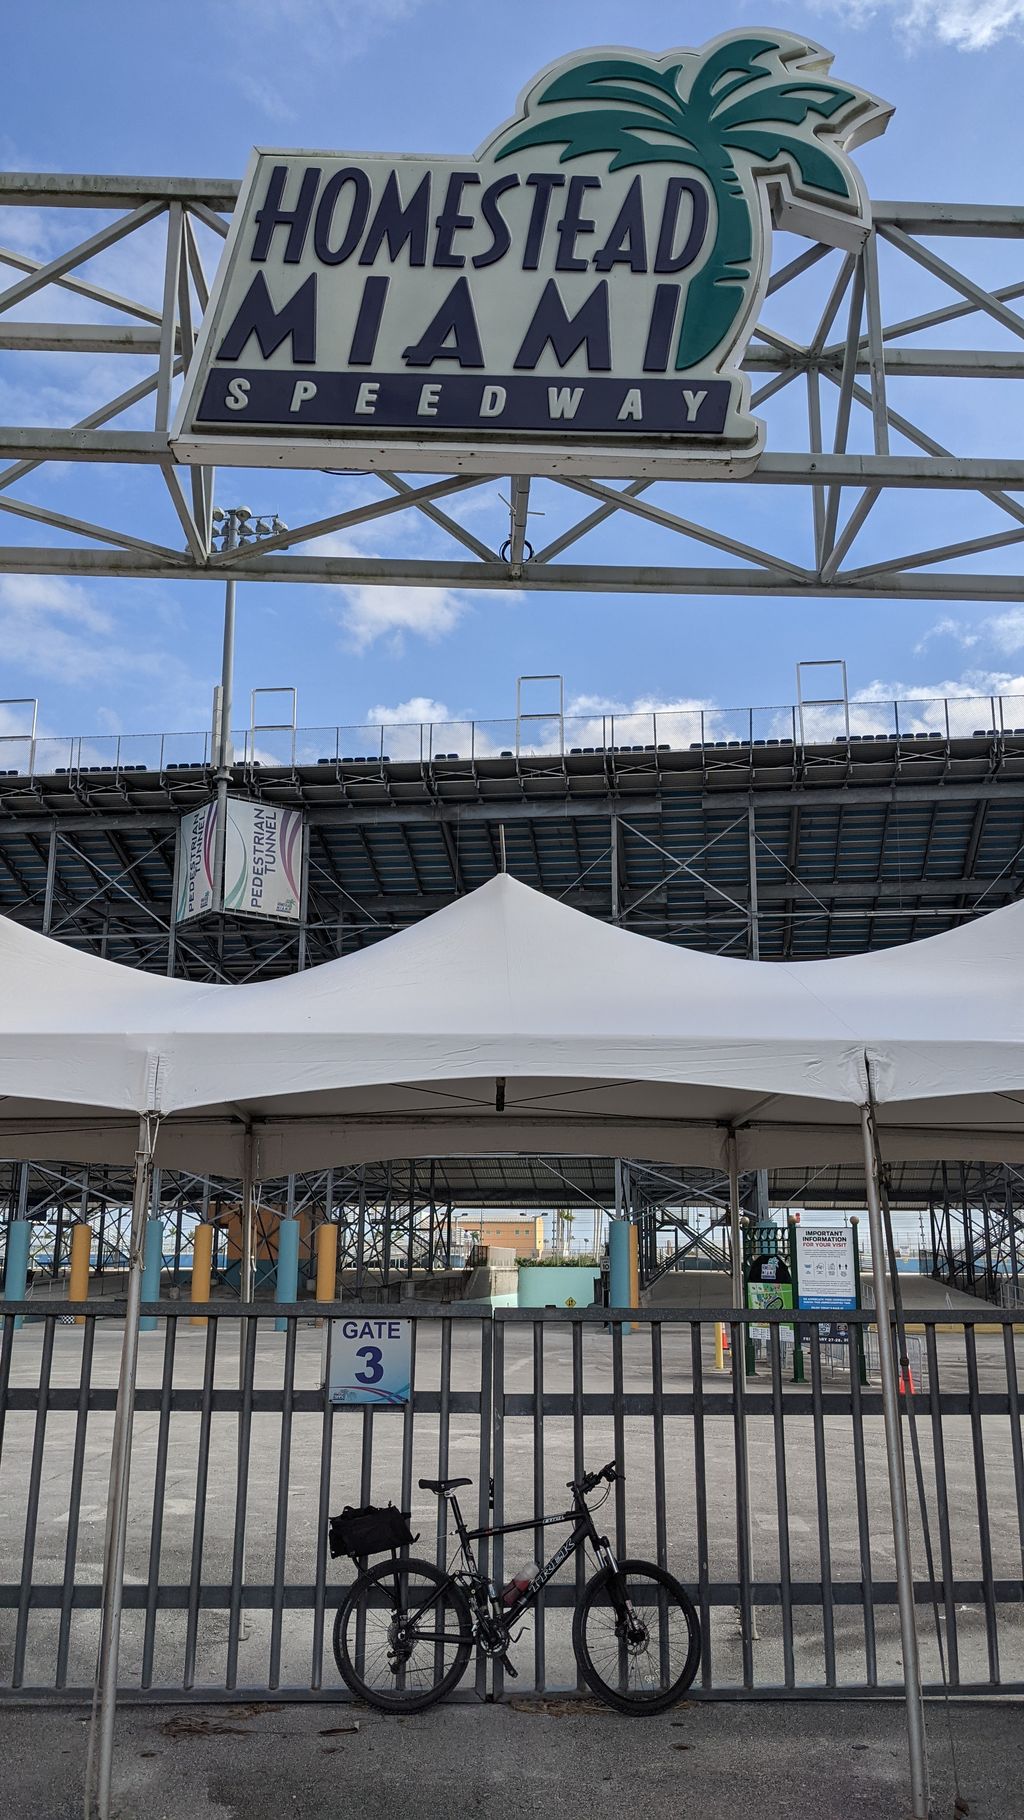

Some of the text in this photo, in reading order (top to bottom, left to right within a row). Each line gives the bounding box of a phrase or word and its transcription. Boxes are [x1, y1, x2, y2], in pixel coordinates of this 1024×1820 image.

[251, 165, 710, 274] HOMESTEAD
[216, 270, 684, 372] MIAMI
[224, 377, 708, 422] SPEEDWAY
[189, 813, 200, 914] PEDESTRIAN
[195, 810, 206, 873] TUNNEL
[251, 807, 265, 909] PEDESTRIAN
[264, 811, 277, 875] TUNNEL
[342, 1321, 401, 1339] GATE
[355, 1345, 384, 1384] 3
[528, 1537, 576, 1593] TREK
